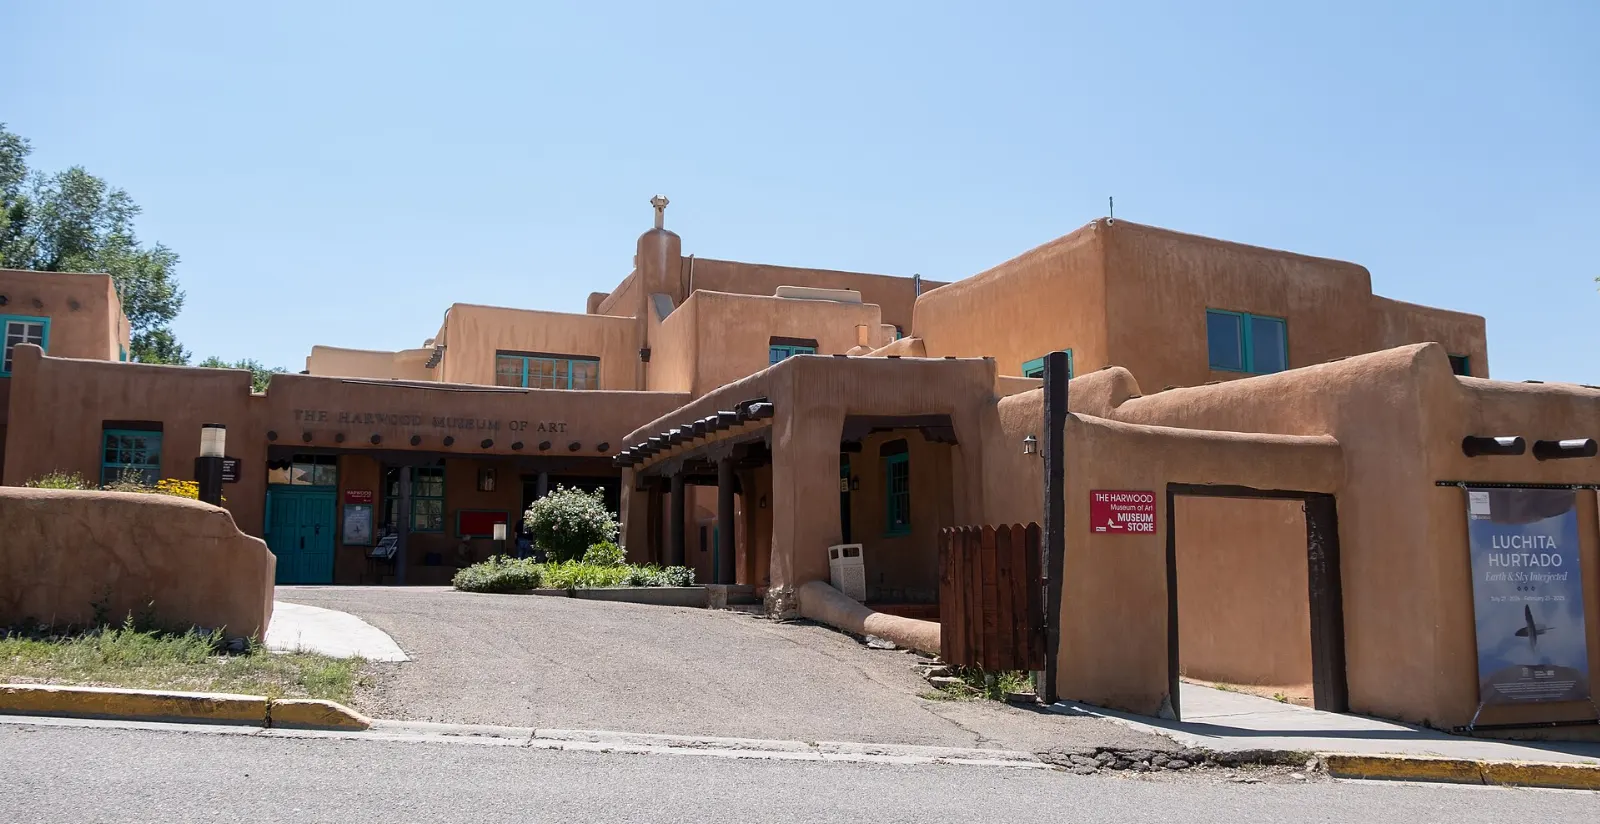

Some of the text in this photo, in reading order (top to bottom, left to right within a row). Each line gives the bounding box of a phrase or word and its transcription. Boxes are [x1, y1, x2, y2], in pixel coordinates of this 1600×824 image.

[293, 409, 567, 433] THE HARWOOD MUSEUM OF ART
[1095, 493, 1153, 503] THE HARWOOD
[1117, 513, 1153, 522] MUSEUM
[1127, 522, 1154, 532] STORE
[1492, 535, 1557, 549] LUCHITA
[1488, 553, 1562, 567] HURTADO
[1485, 571, 1568, 584] Earth & Sky Interjected
